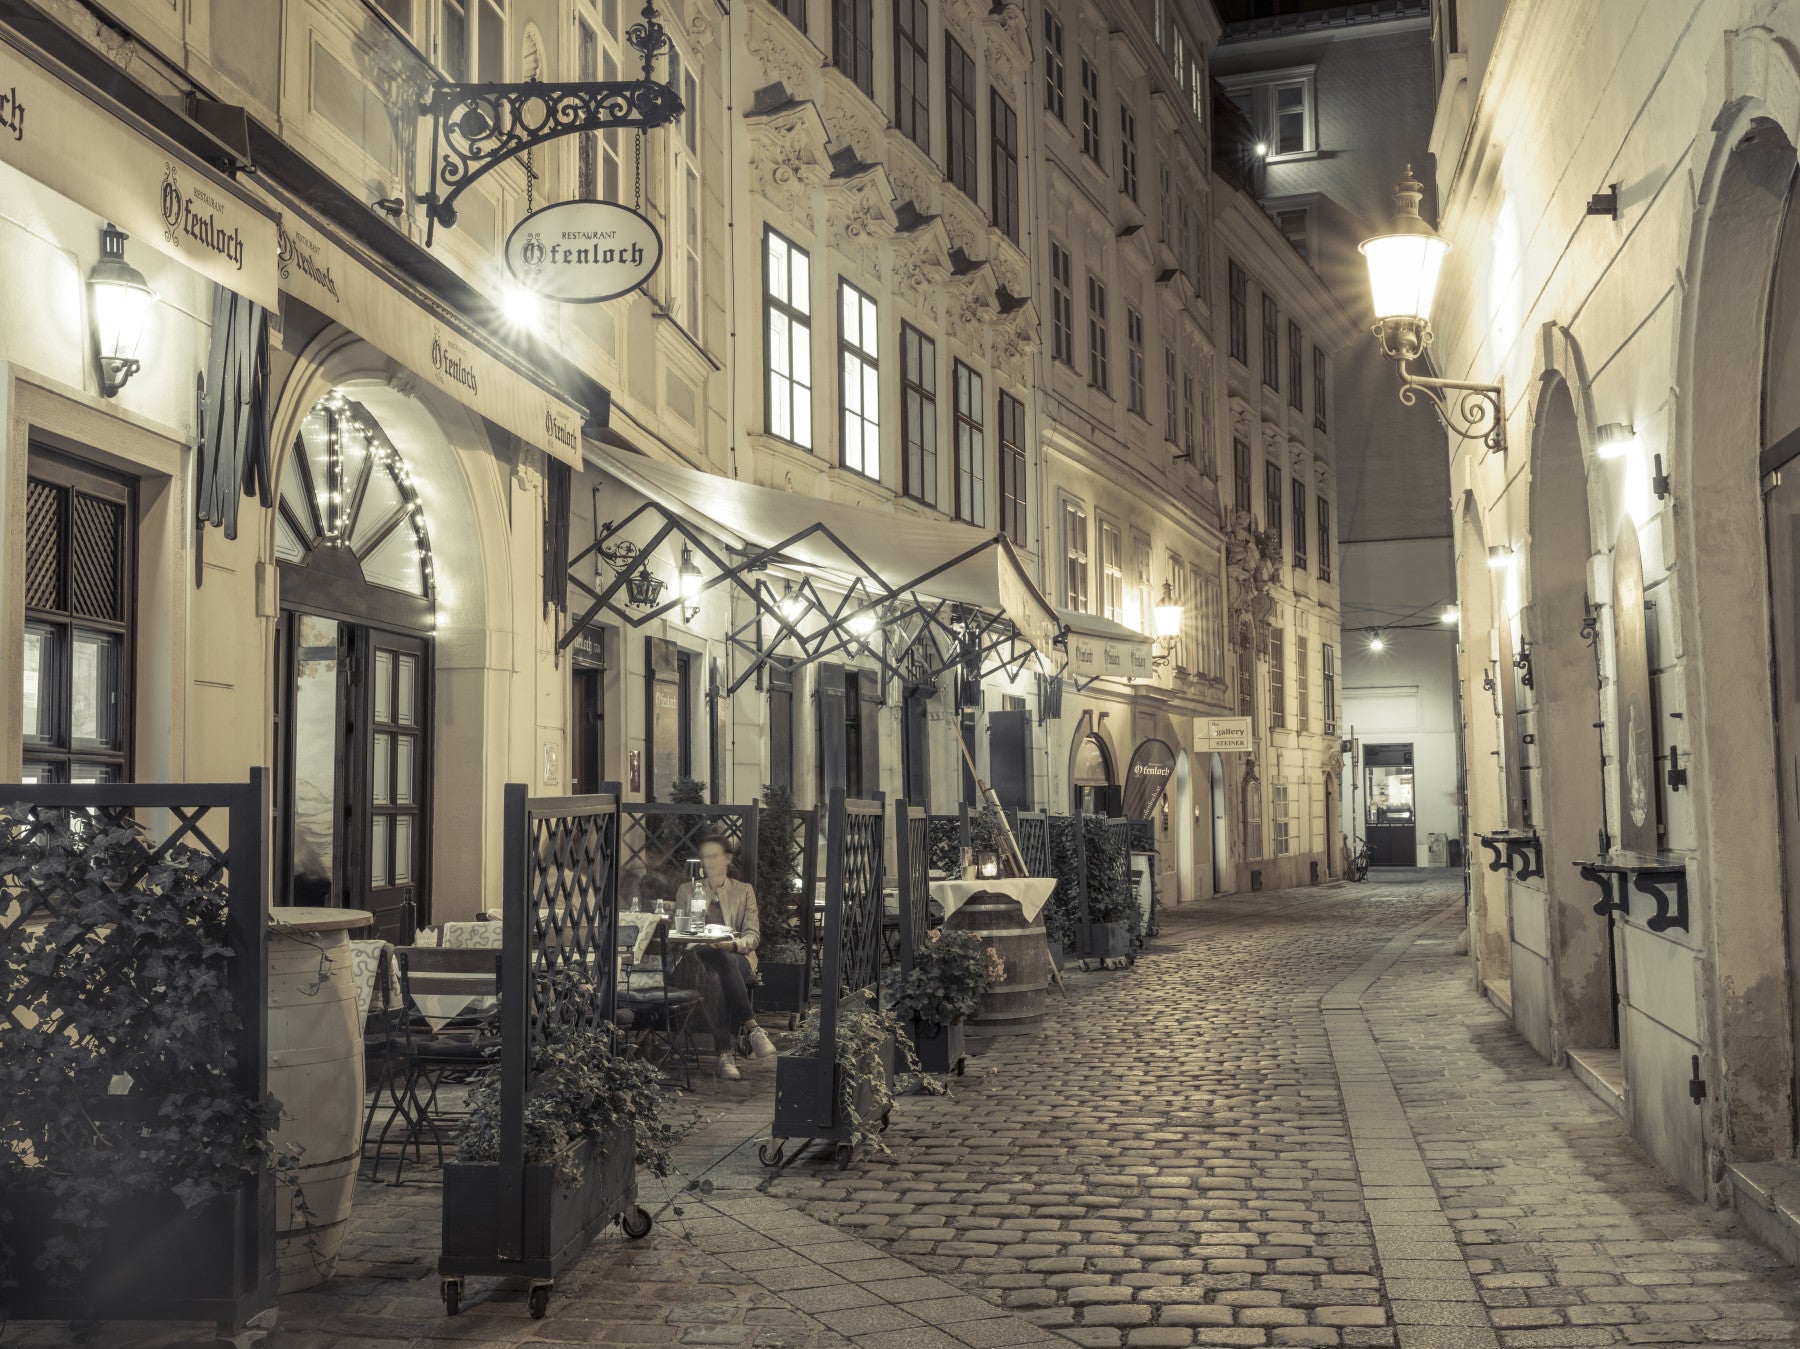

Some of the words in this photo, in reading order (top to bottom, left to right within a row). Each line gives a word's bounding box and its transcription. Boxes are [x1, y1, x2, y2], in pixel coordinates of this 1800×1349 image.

[193, 187, 225, 215] RESTAURANT
[162, 182, 244, 271] Ofenloch
[562, 231, 616, 240] RESTAURANT
[521, 240, 644, 267] Ofenloch
[431, 339, 478, 396] Ofenloch
[545, 410, 577, 455] Ofenloch
[1216, 728, 1245, 737] gallery
